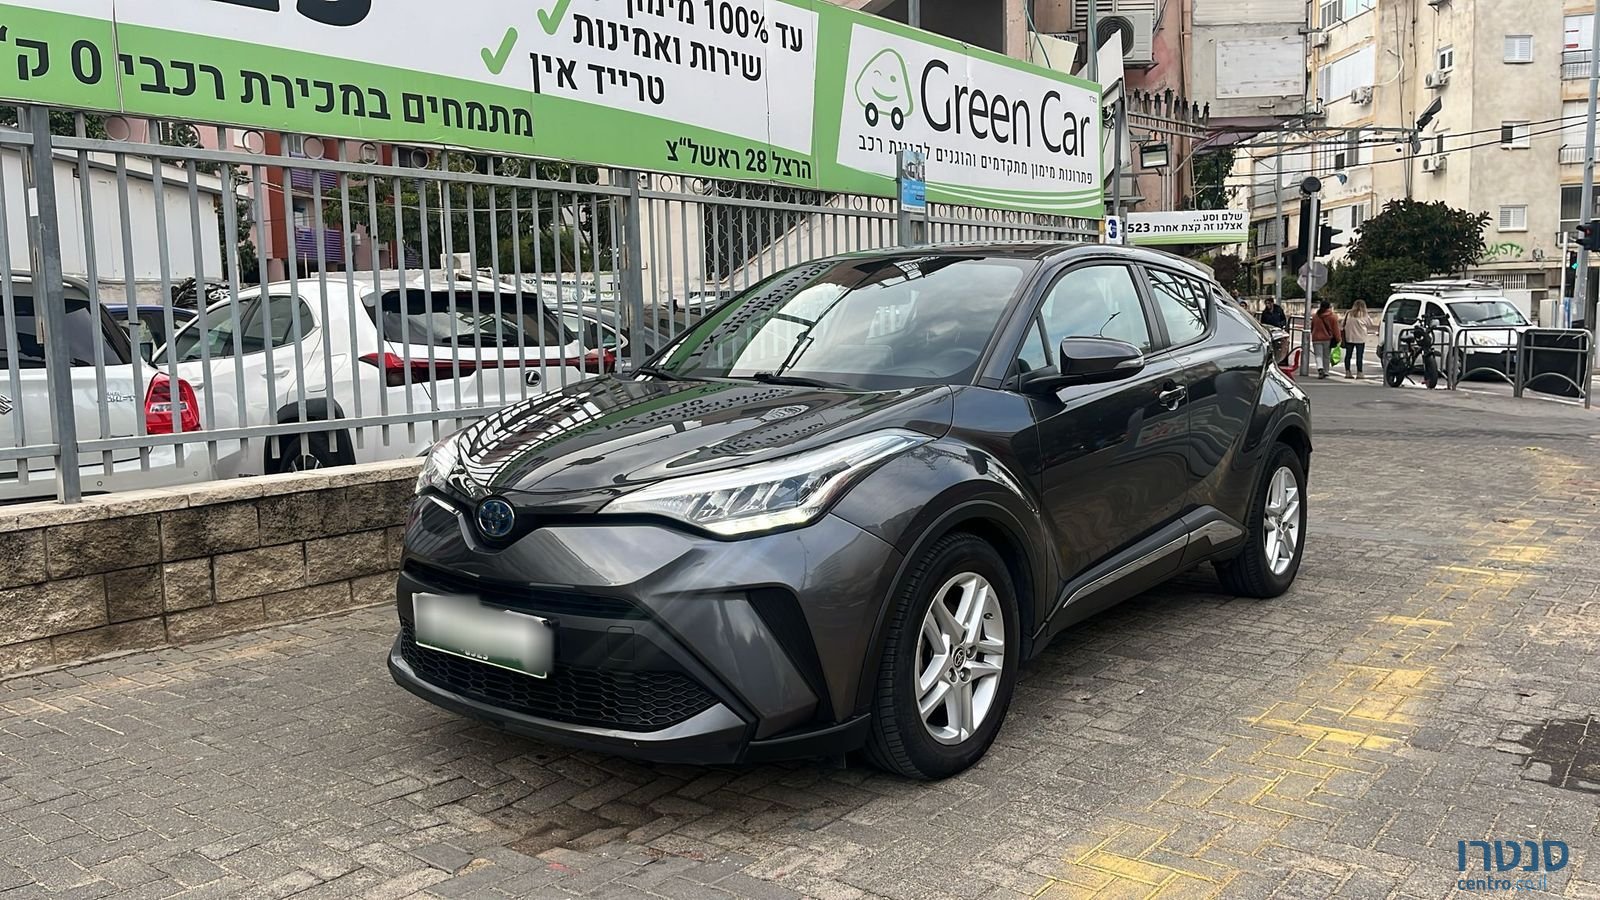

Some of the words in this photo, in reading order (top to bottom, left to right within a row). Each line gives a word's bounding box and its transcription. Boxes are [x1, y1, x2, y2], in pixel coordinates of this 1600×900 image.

[704, 1, 768, 43] 100%
[573, 14, 681, 64] ואמינות
[776, 22, 803, 52] עד
[530, 53, 577, 94] אין
[690, 40, 762, 81] שירות
[120, 54, 224, 100] רכבי
[588, 64, 664, 104] טרייד
[240, 70, 390, 119] במכירת
[402, 92, 533, 137] מתמחים
[920, 59, 1031, 147] Green
[1040, 91, 1090, 157] Car
[858, 135, 883, 152] רכב
[745, 148, 767, 173] 28
[772, 151, 812, 179] הרצל
[936, 147, 976, 167] והוגנים
[981, 156, 1027, 175] מתקדמים
[1031, 162, 1055, 180] מימון
[1059, 168, 1092, 185] פתרונות
[1127, 223, 1151, 233] 523
[1153, 225, 1179, 233] אחרת
[1181, 224, 1201, 233] קצת
[1216, 222, 1243, 231] אצלנו
[1222, 212, 1243, 221] שלם
